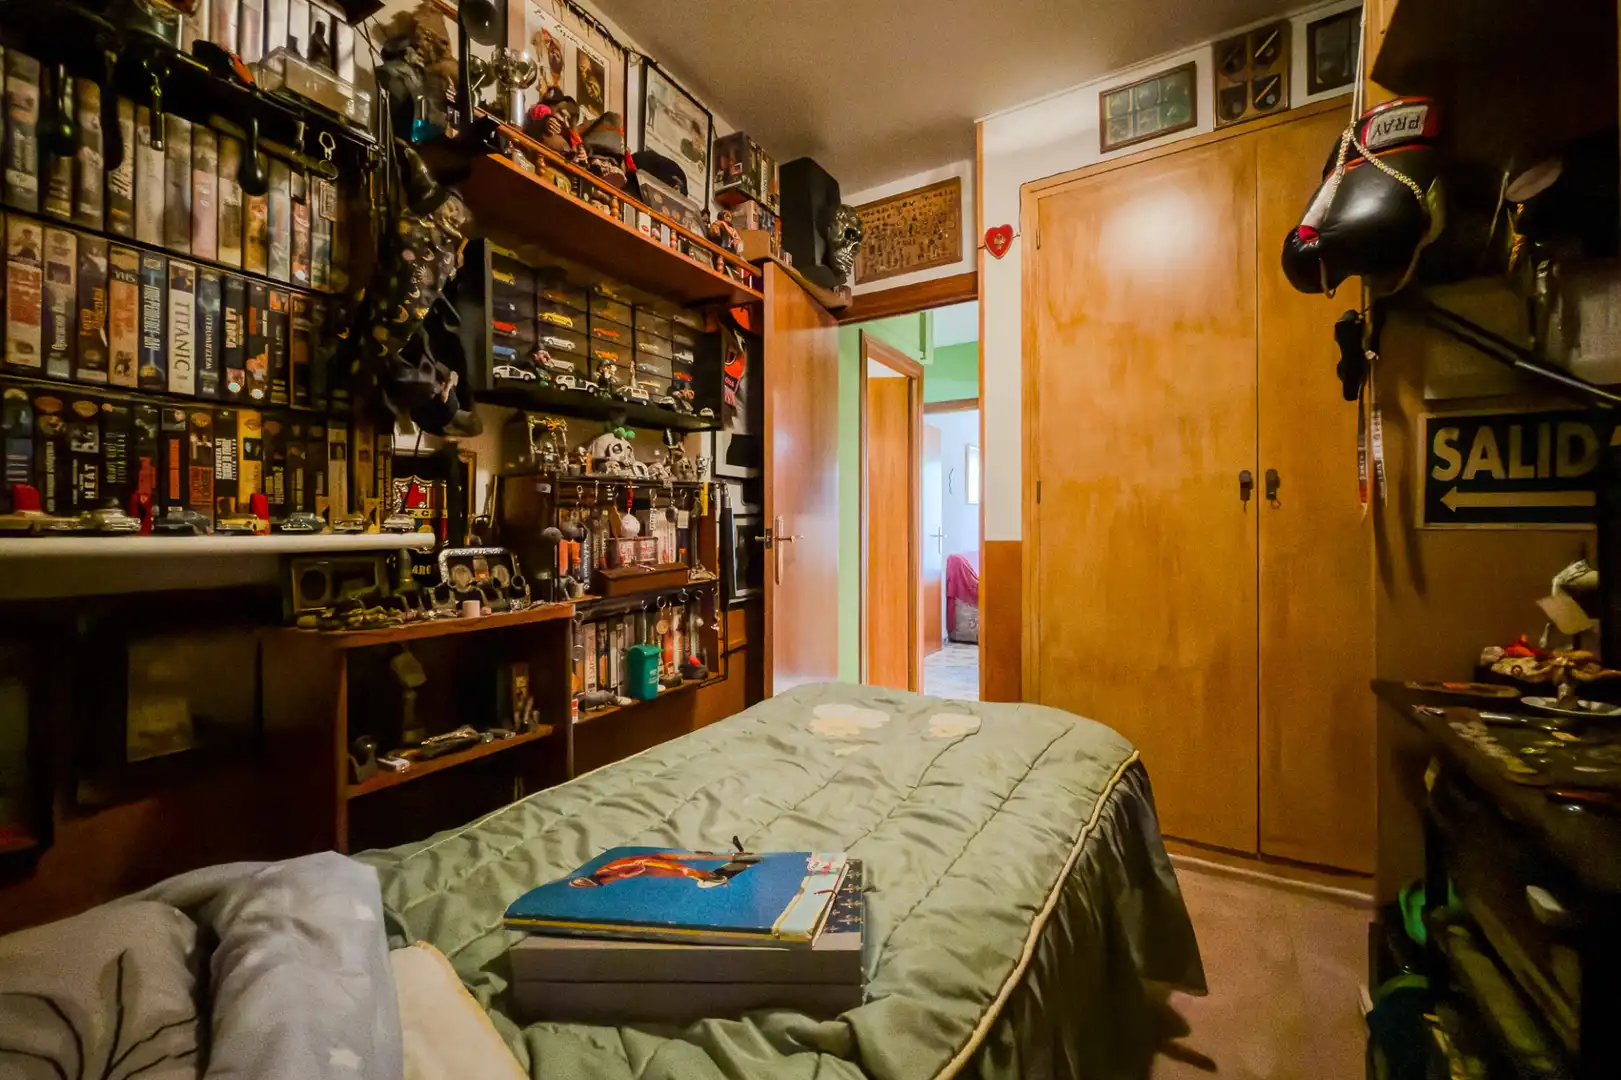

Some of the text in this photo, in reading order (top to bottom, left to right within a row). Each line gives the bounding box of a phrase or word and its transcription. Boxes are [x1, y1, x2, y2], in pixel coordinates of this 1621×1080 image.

[1370, 115, 1420, 140] PRAY
[114, 270, 136, 283] VHS
[144, 285, 161, 351] INDEPENDENCE DAY
[174, 301, 190, 372] TITANIC
[204, 313, 214, 369] WATERWORLD
[225, 307, 237, 348] LA ROCA
[1431, 421, 1621, 482] SALID
[84, 464, 95, 499] HEAT
